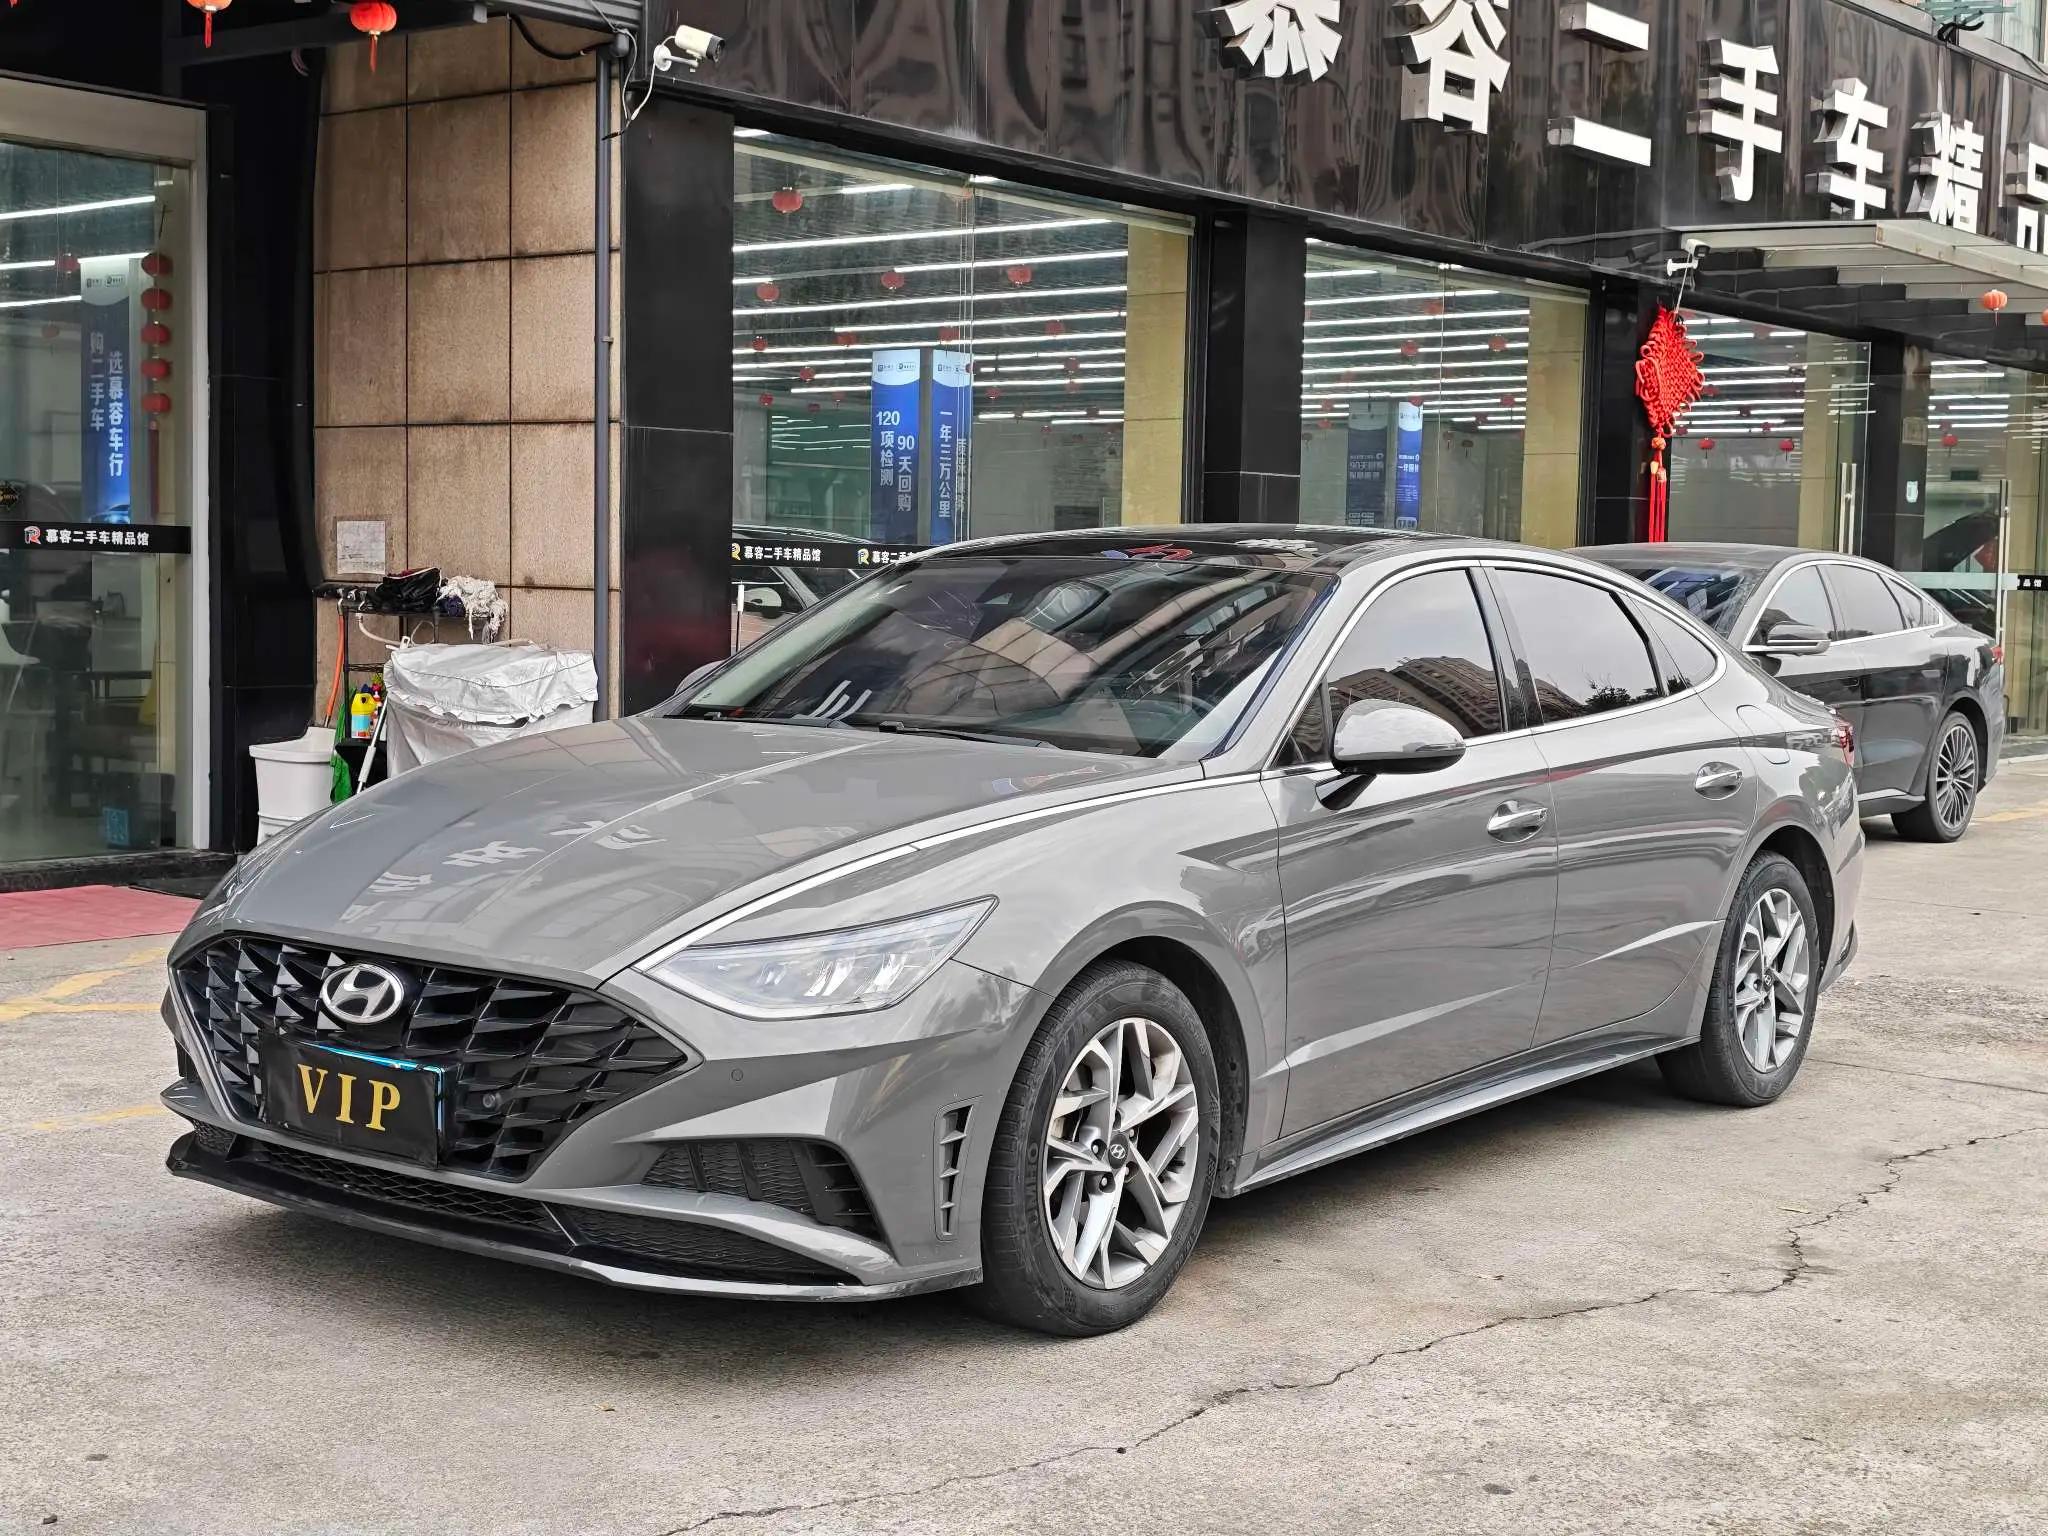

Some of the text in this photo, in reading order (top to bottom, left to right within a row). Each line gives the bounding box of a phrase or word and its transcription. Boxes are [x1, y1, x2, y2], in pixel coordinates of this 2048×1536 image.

[108, 350, 124, 477] 选慕容车行
[938, 410, 953, 518] 一年三万公里
[46, 529, 149, 546] 慕容二手车精品馆
[744, 545, 821, 562] 慕容二手车精品馆
[297, 1064, 401, 1131] VIP
